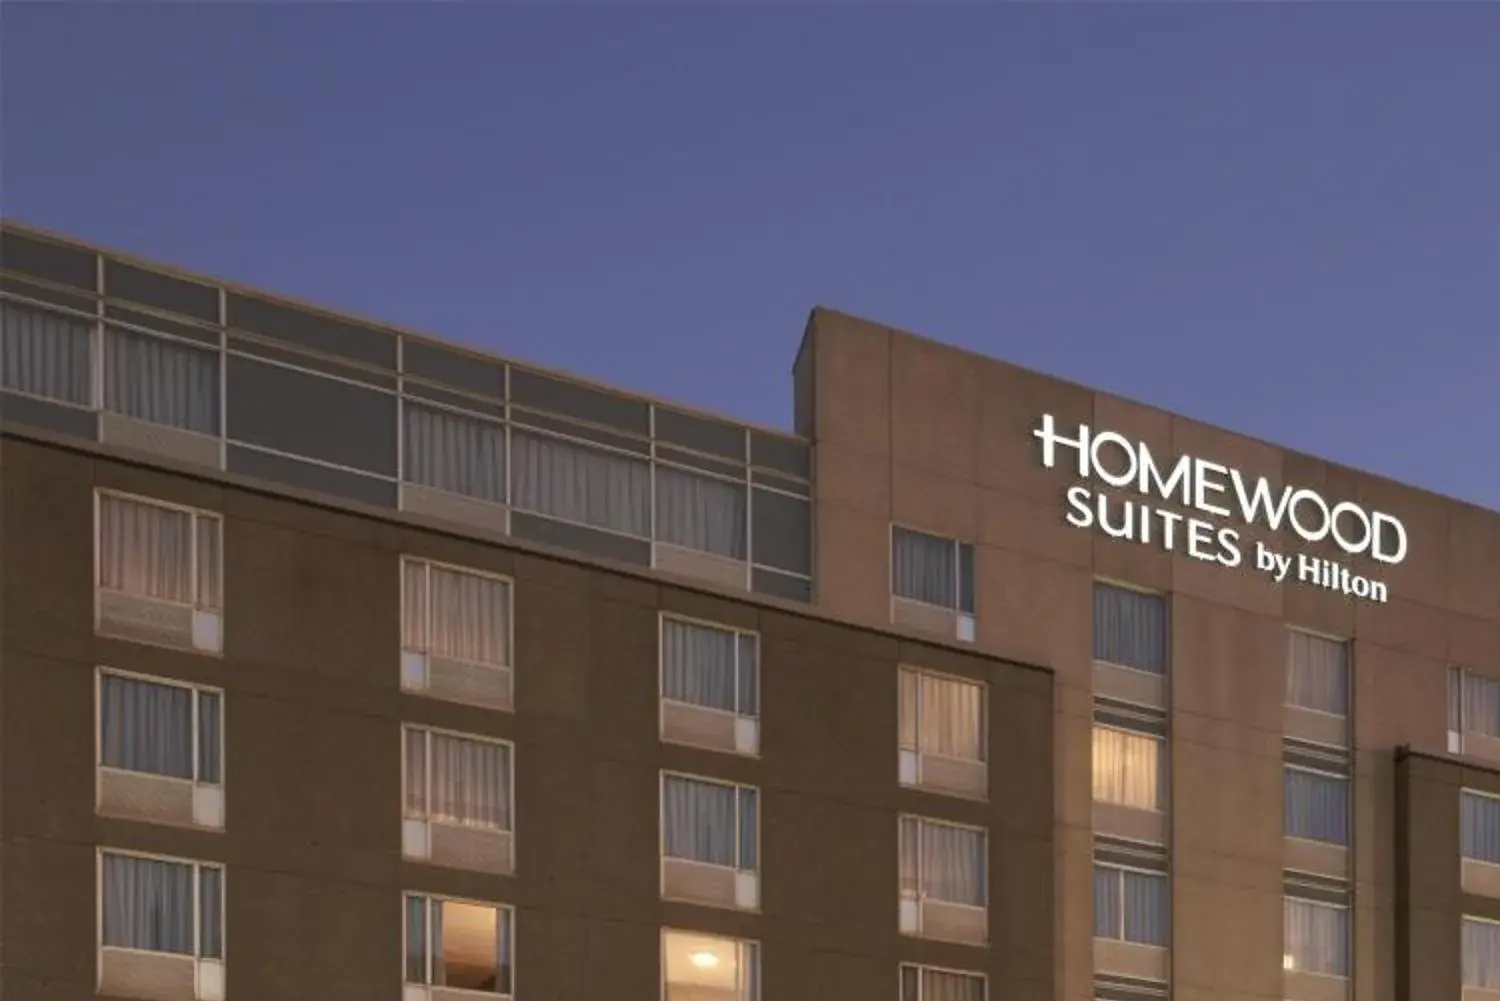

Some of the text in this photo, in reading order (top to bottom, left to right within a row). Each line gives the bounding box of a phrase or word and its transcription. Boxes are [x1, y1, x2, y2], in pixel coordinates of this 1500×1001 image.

[1033, 413, 1408, 565] HOMEWOOD
[1065, 486, 1388, 604] SUITES by Hilton
